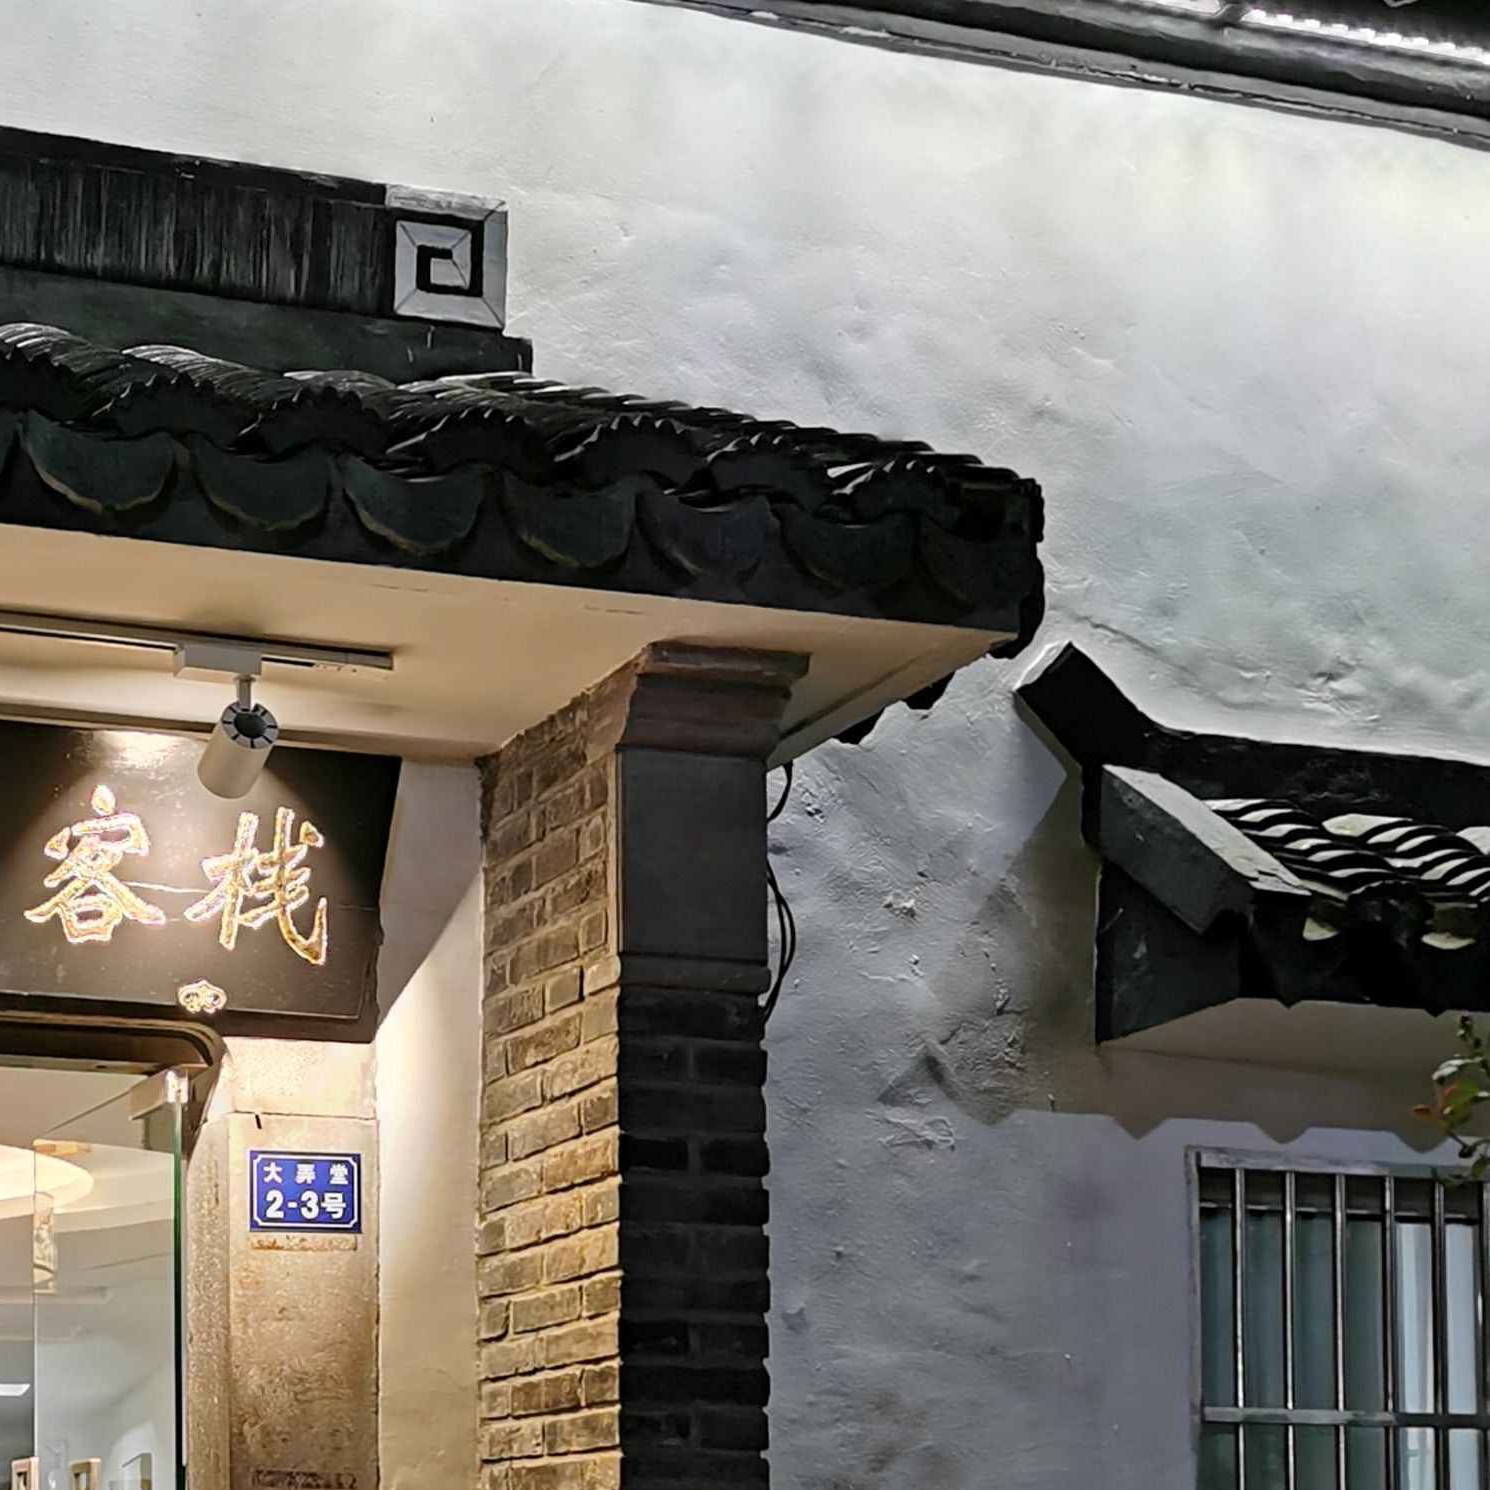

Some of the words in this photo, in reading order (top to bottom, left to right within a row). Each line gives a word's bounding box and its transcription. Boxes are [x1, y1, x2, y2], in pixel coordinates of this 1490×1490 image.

[263, 1162, 349, 1185] 大弄堂
[265, 1190, 346, 1219] 2-3号
